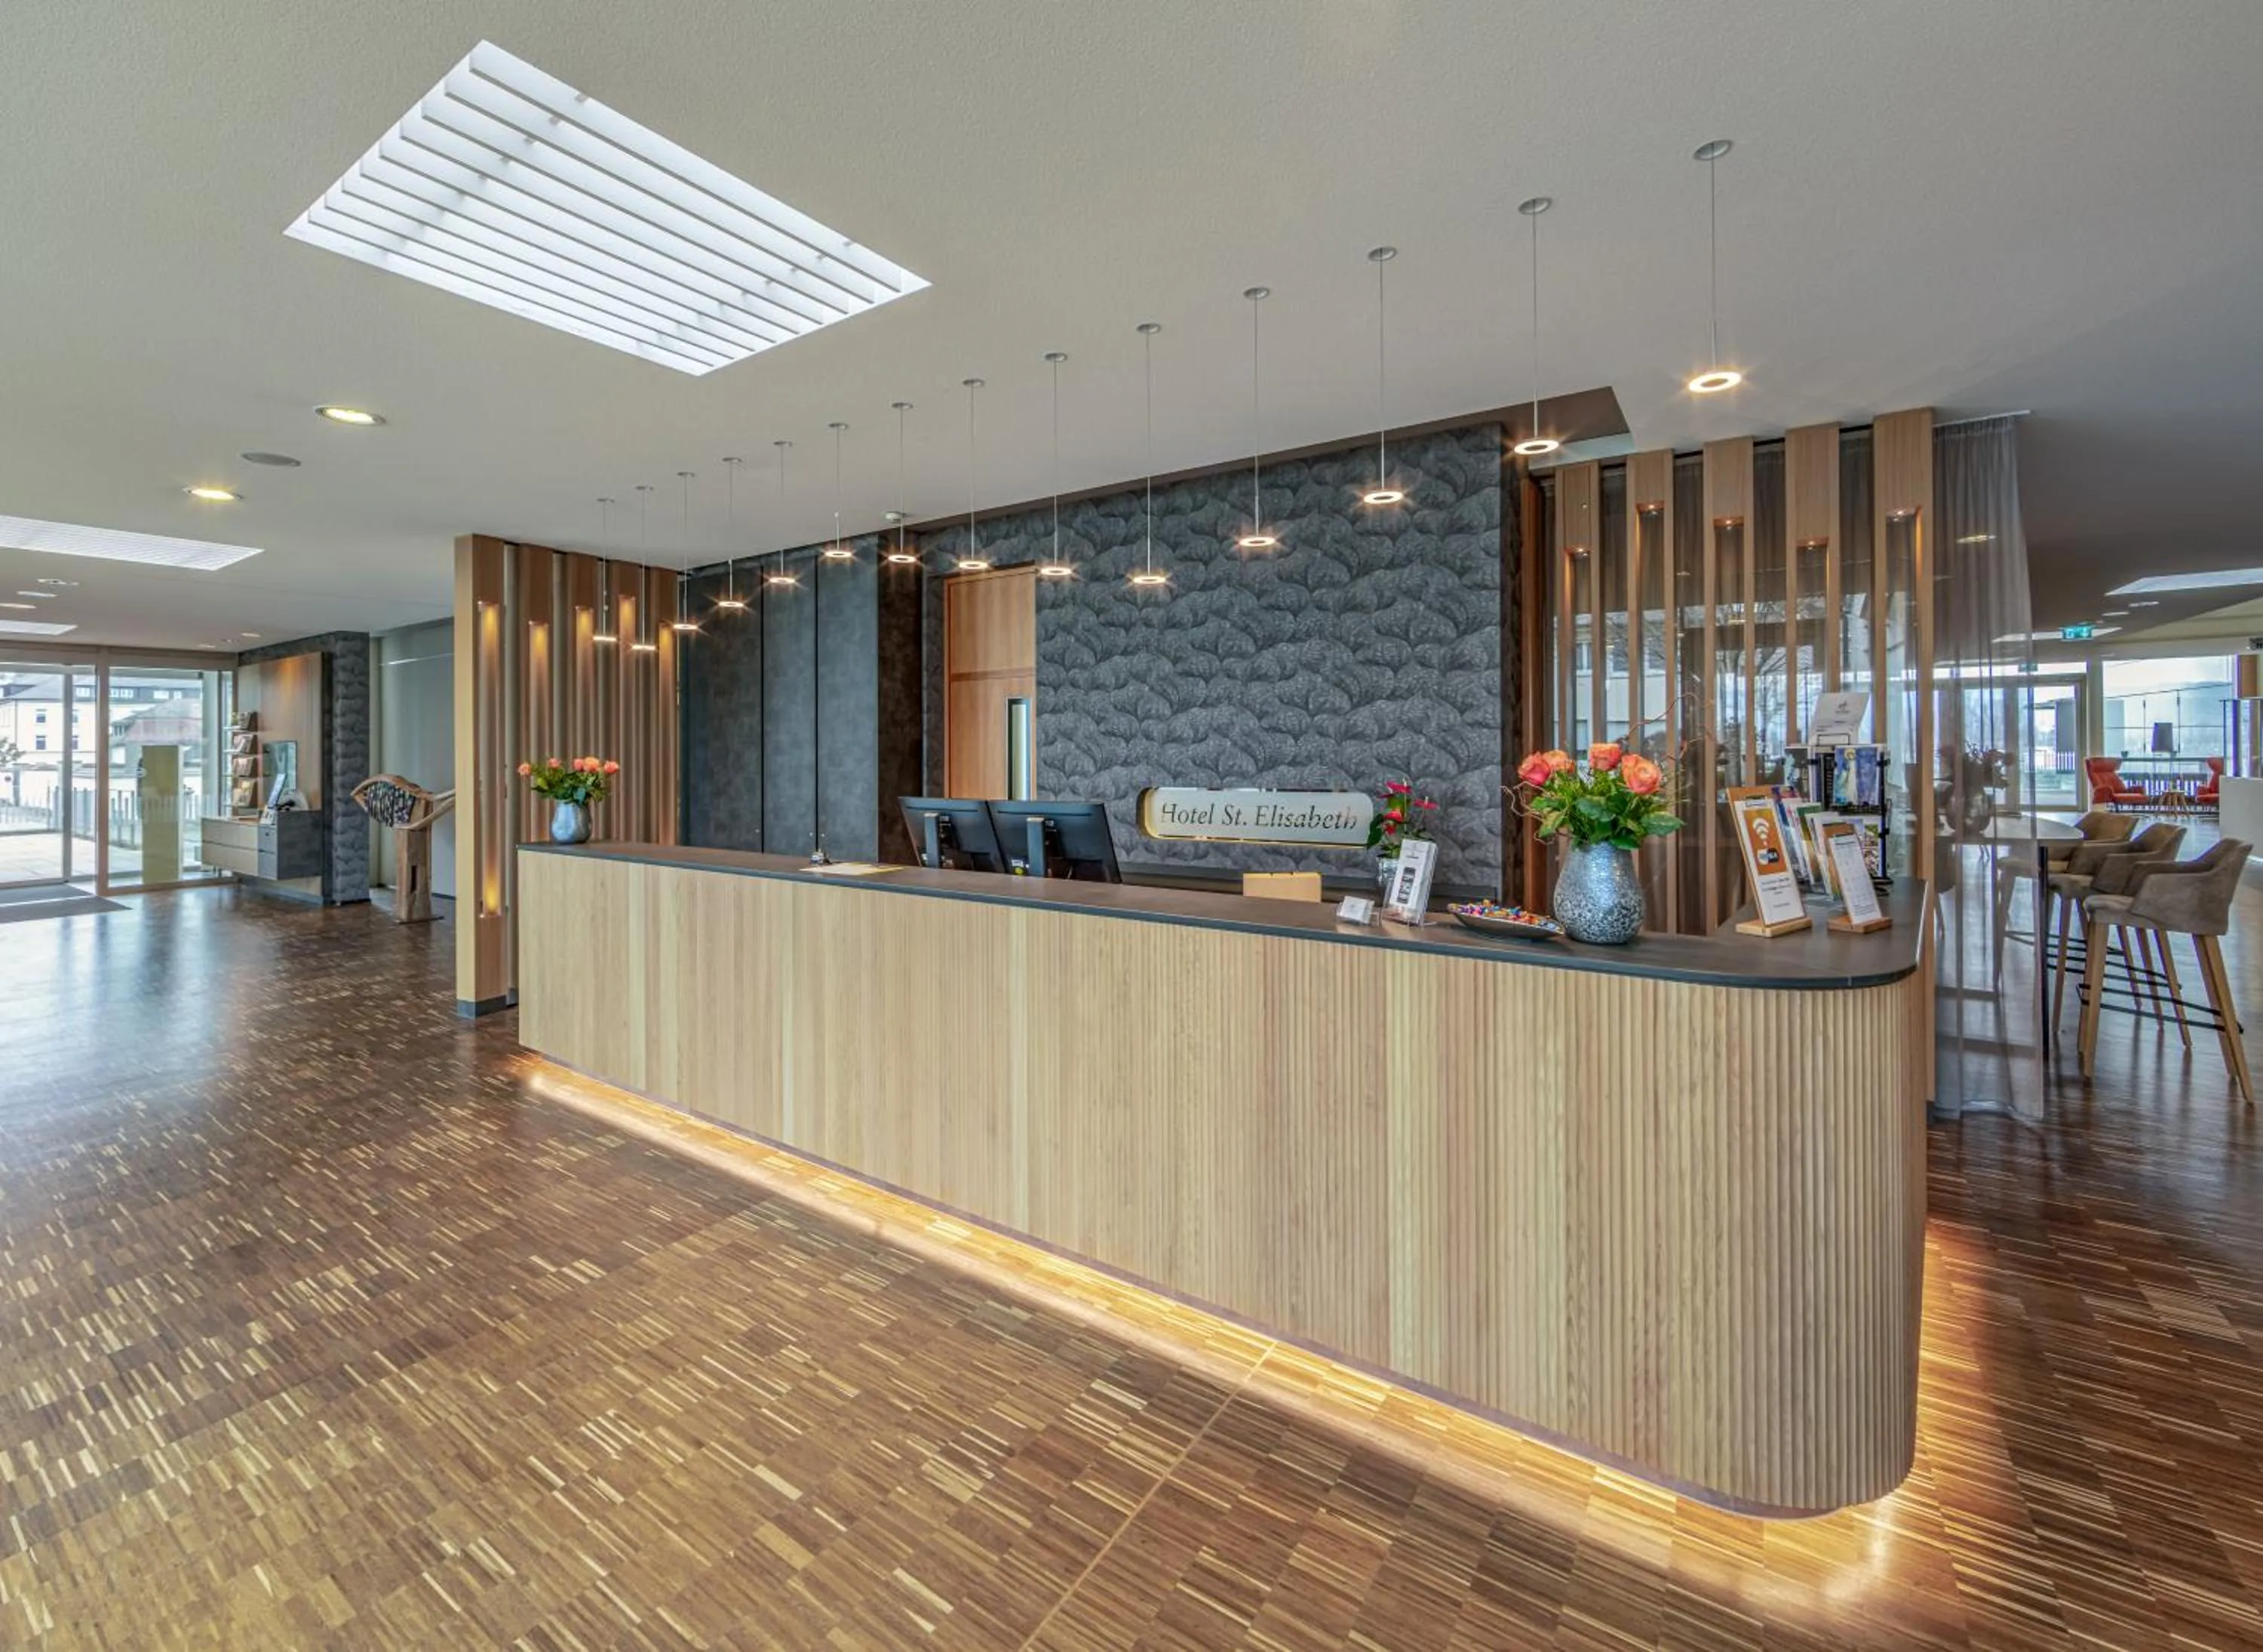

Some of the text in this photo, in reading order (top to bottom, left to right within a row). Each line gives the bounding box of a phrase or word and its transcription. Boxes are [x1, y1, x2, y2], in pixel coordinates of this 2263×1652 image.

[1161, 803, 1358, 830] Hotel St. Elisabeth
